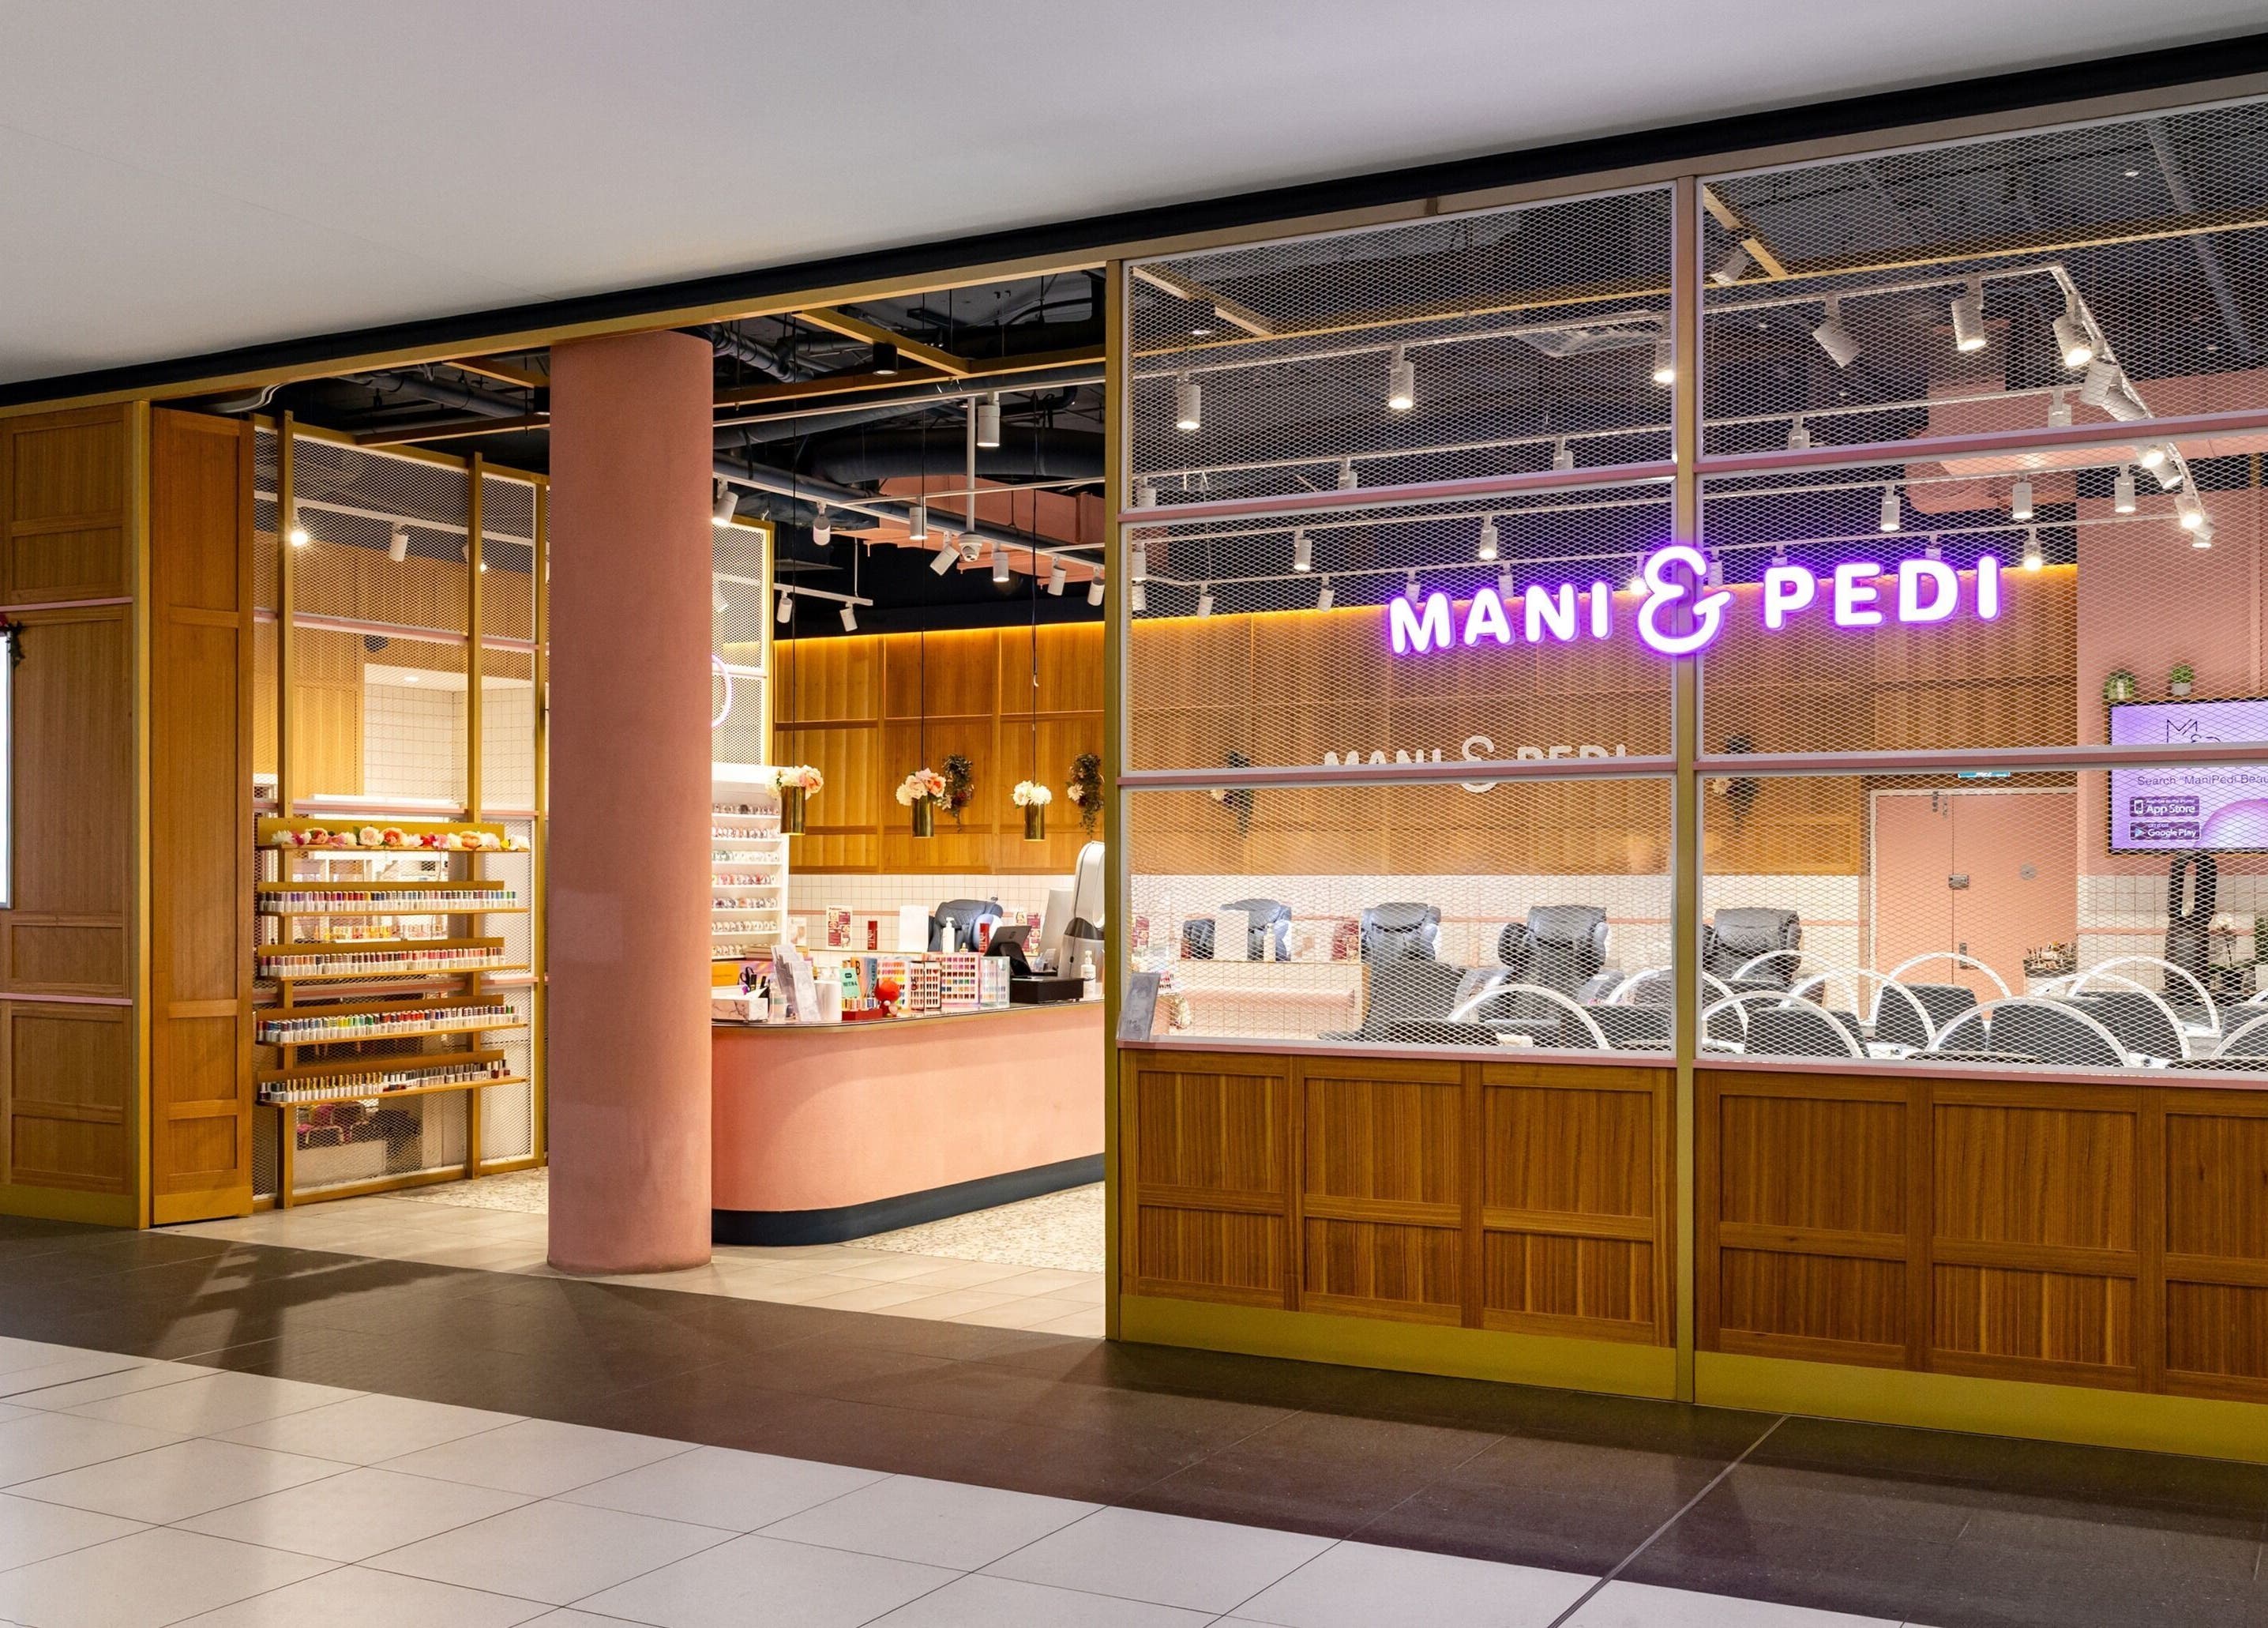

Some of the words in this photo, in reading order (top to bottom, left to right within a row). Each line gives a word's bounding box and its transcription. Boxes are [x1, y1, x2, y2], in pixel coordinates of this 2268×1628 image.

[1389, 581, 1613, 655] MANI
[1636, 544, 1734, 656] &
[1763, 555, 2000, 630] PEDI
[2137, 775, 2176, 786] Search
[2146, 804, 2168, 815] App
[2168, 803, 2195, 814] Store
[2147, 828, 2177, 838] Google
[2178, 828, 2197, 838] Play
